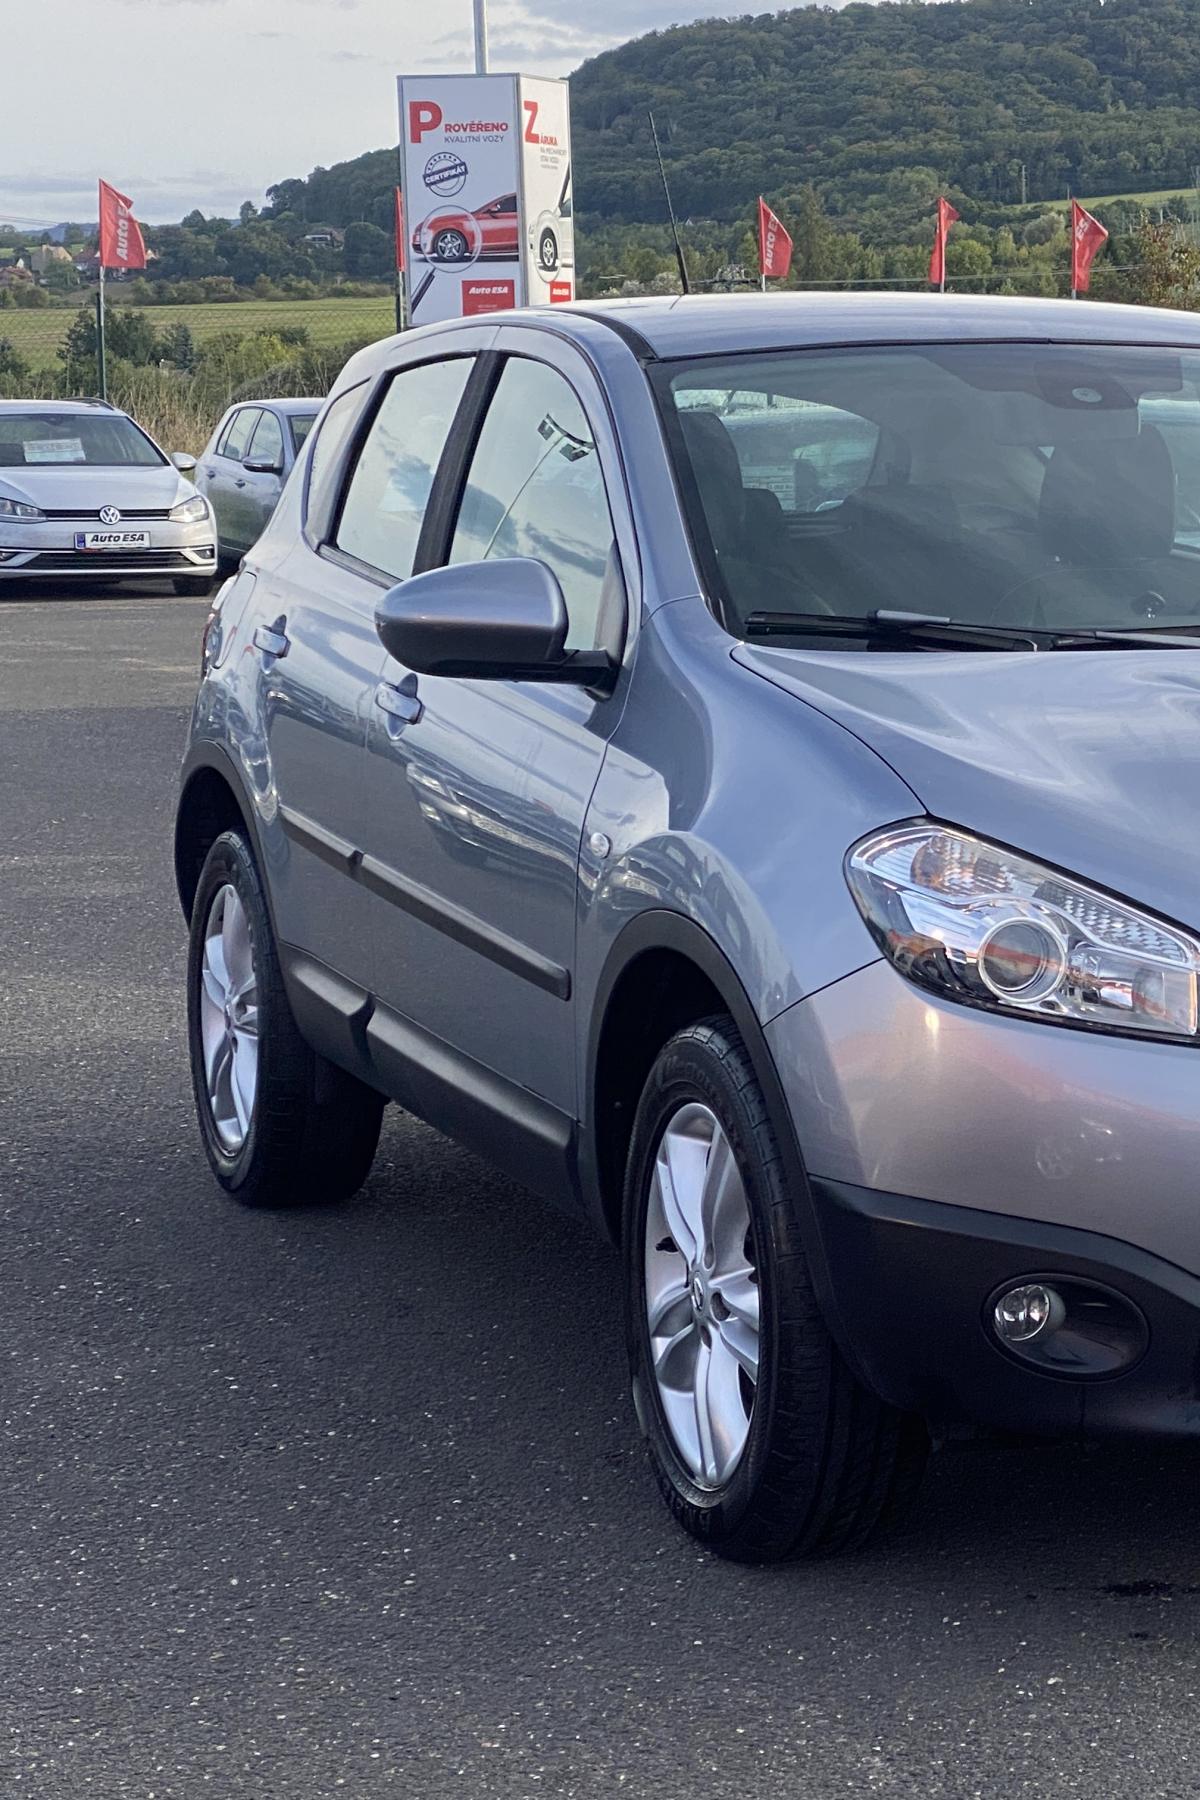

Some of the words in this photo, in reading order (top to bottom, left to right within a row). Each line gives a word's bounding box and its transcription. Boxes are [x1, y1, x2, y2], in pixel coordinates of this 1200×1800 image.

[444, 134, 480, 143] KVALITNÍ
[116, 219, 128, 261] Auto
[765, 231, 776, 269] Auto
[469, 287, 491, 295] Auto
[90, 533, 120, 543] Auto
[121, 533, 145, 542] ESA
